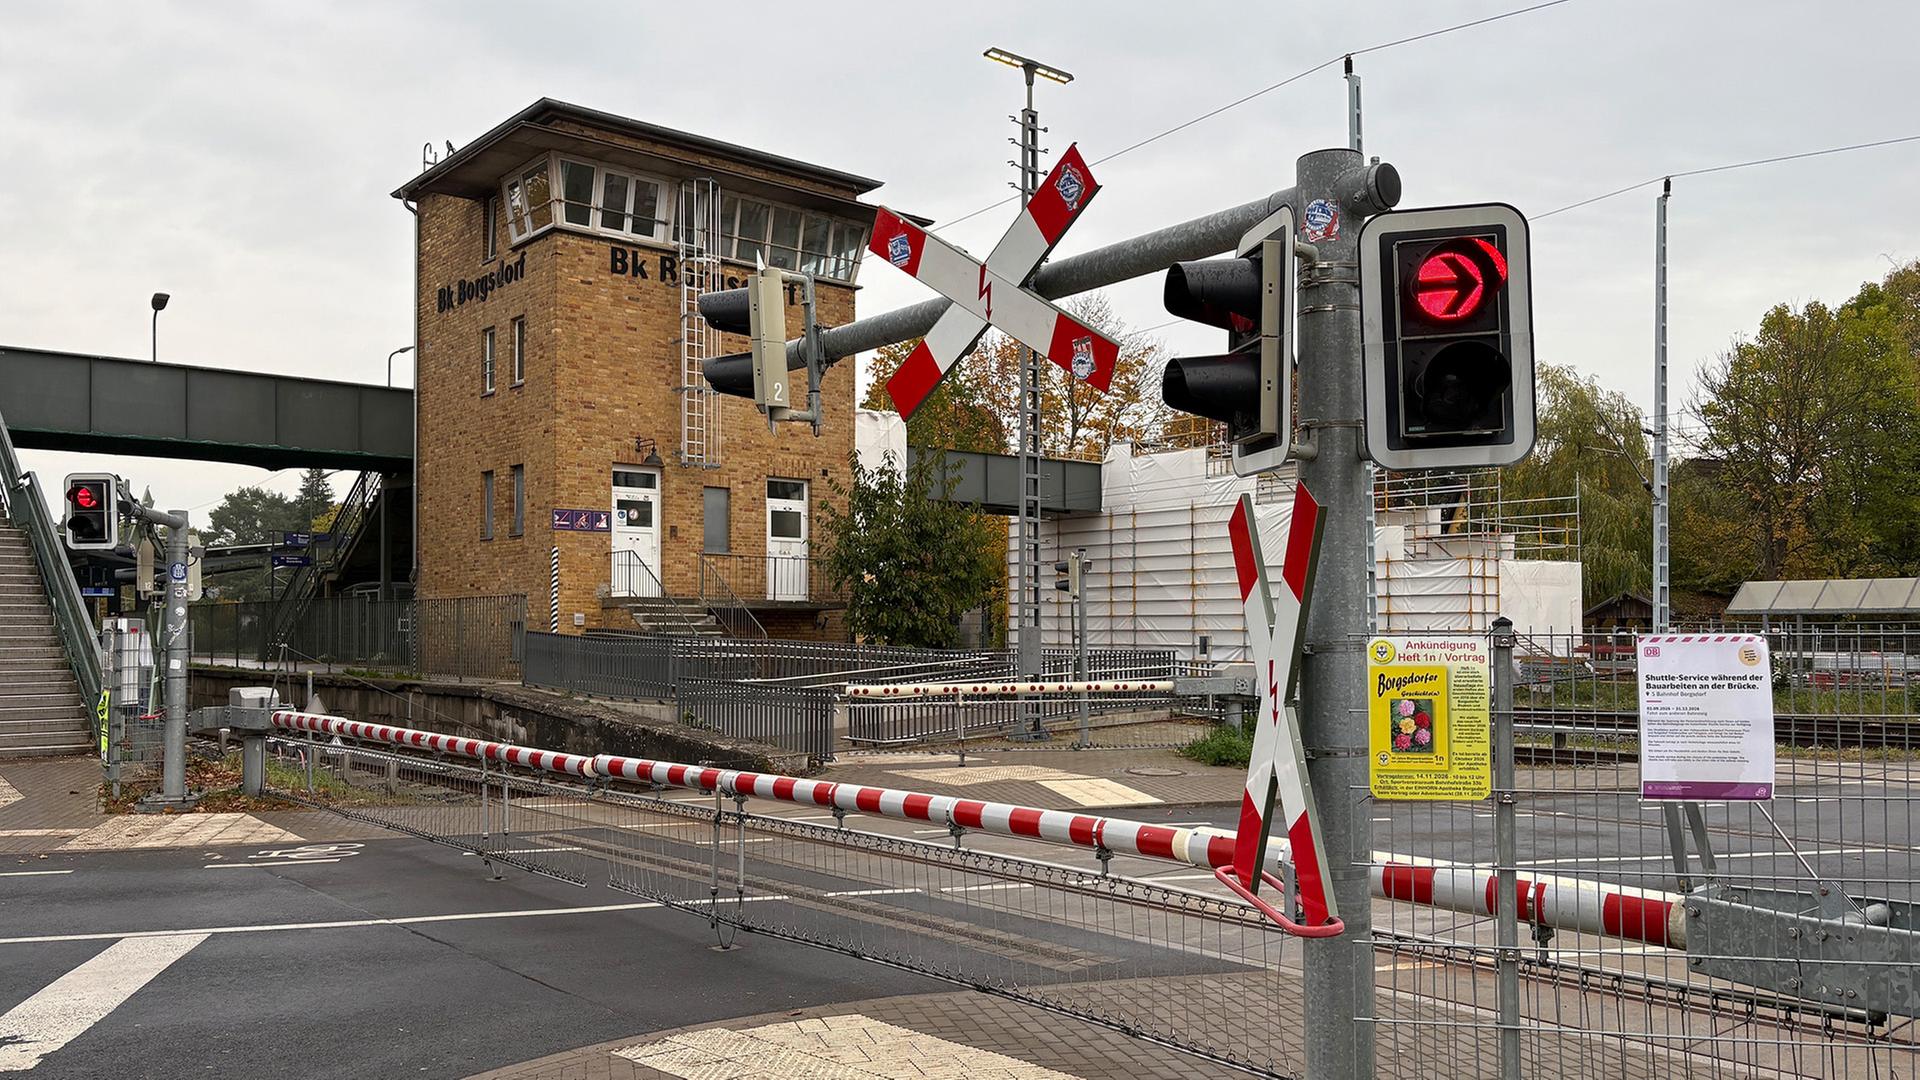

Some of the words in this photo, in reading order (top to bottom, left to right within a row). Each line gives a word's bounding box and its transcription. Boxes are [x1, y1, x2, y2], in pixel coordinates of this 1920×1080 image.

[610, 246, 648, 279] Bk
[437, 284, 454, 313] Bk
[457, 250, 527, 305] Borgsdorf
[774, 382, 783, 401] 2
[1405, 640, 1477, 651] Ankündigung
[1645, 648, 1659, 656] DB
[1398, 653, 1421, 662] Heft
[1423, 653, 1436, 662] 1n
[1444, 653, 1485, 664] Vortrag
[1645, 674, 1709, 682] Shuttle-Service
[1377, 672, 1438, 698] Borgsdorfer
[1646, 682, 1697, 690] Bauarbeiten
[1727, 682, 1759, 690] Brücke.
